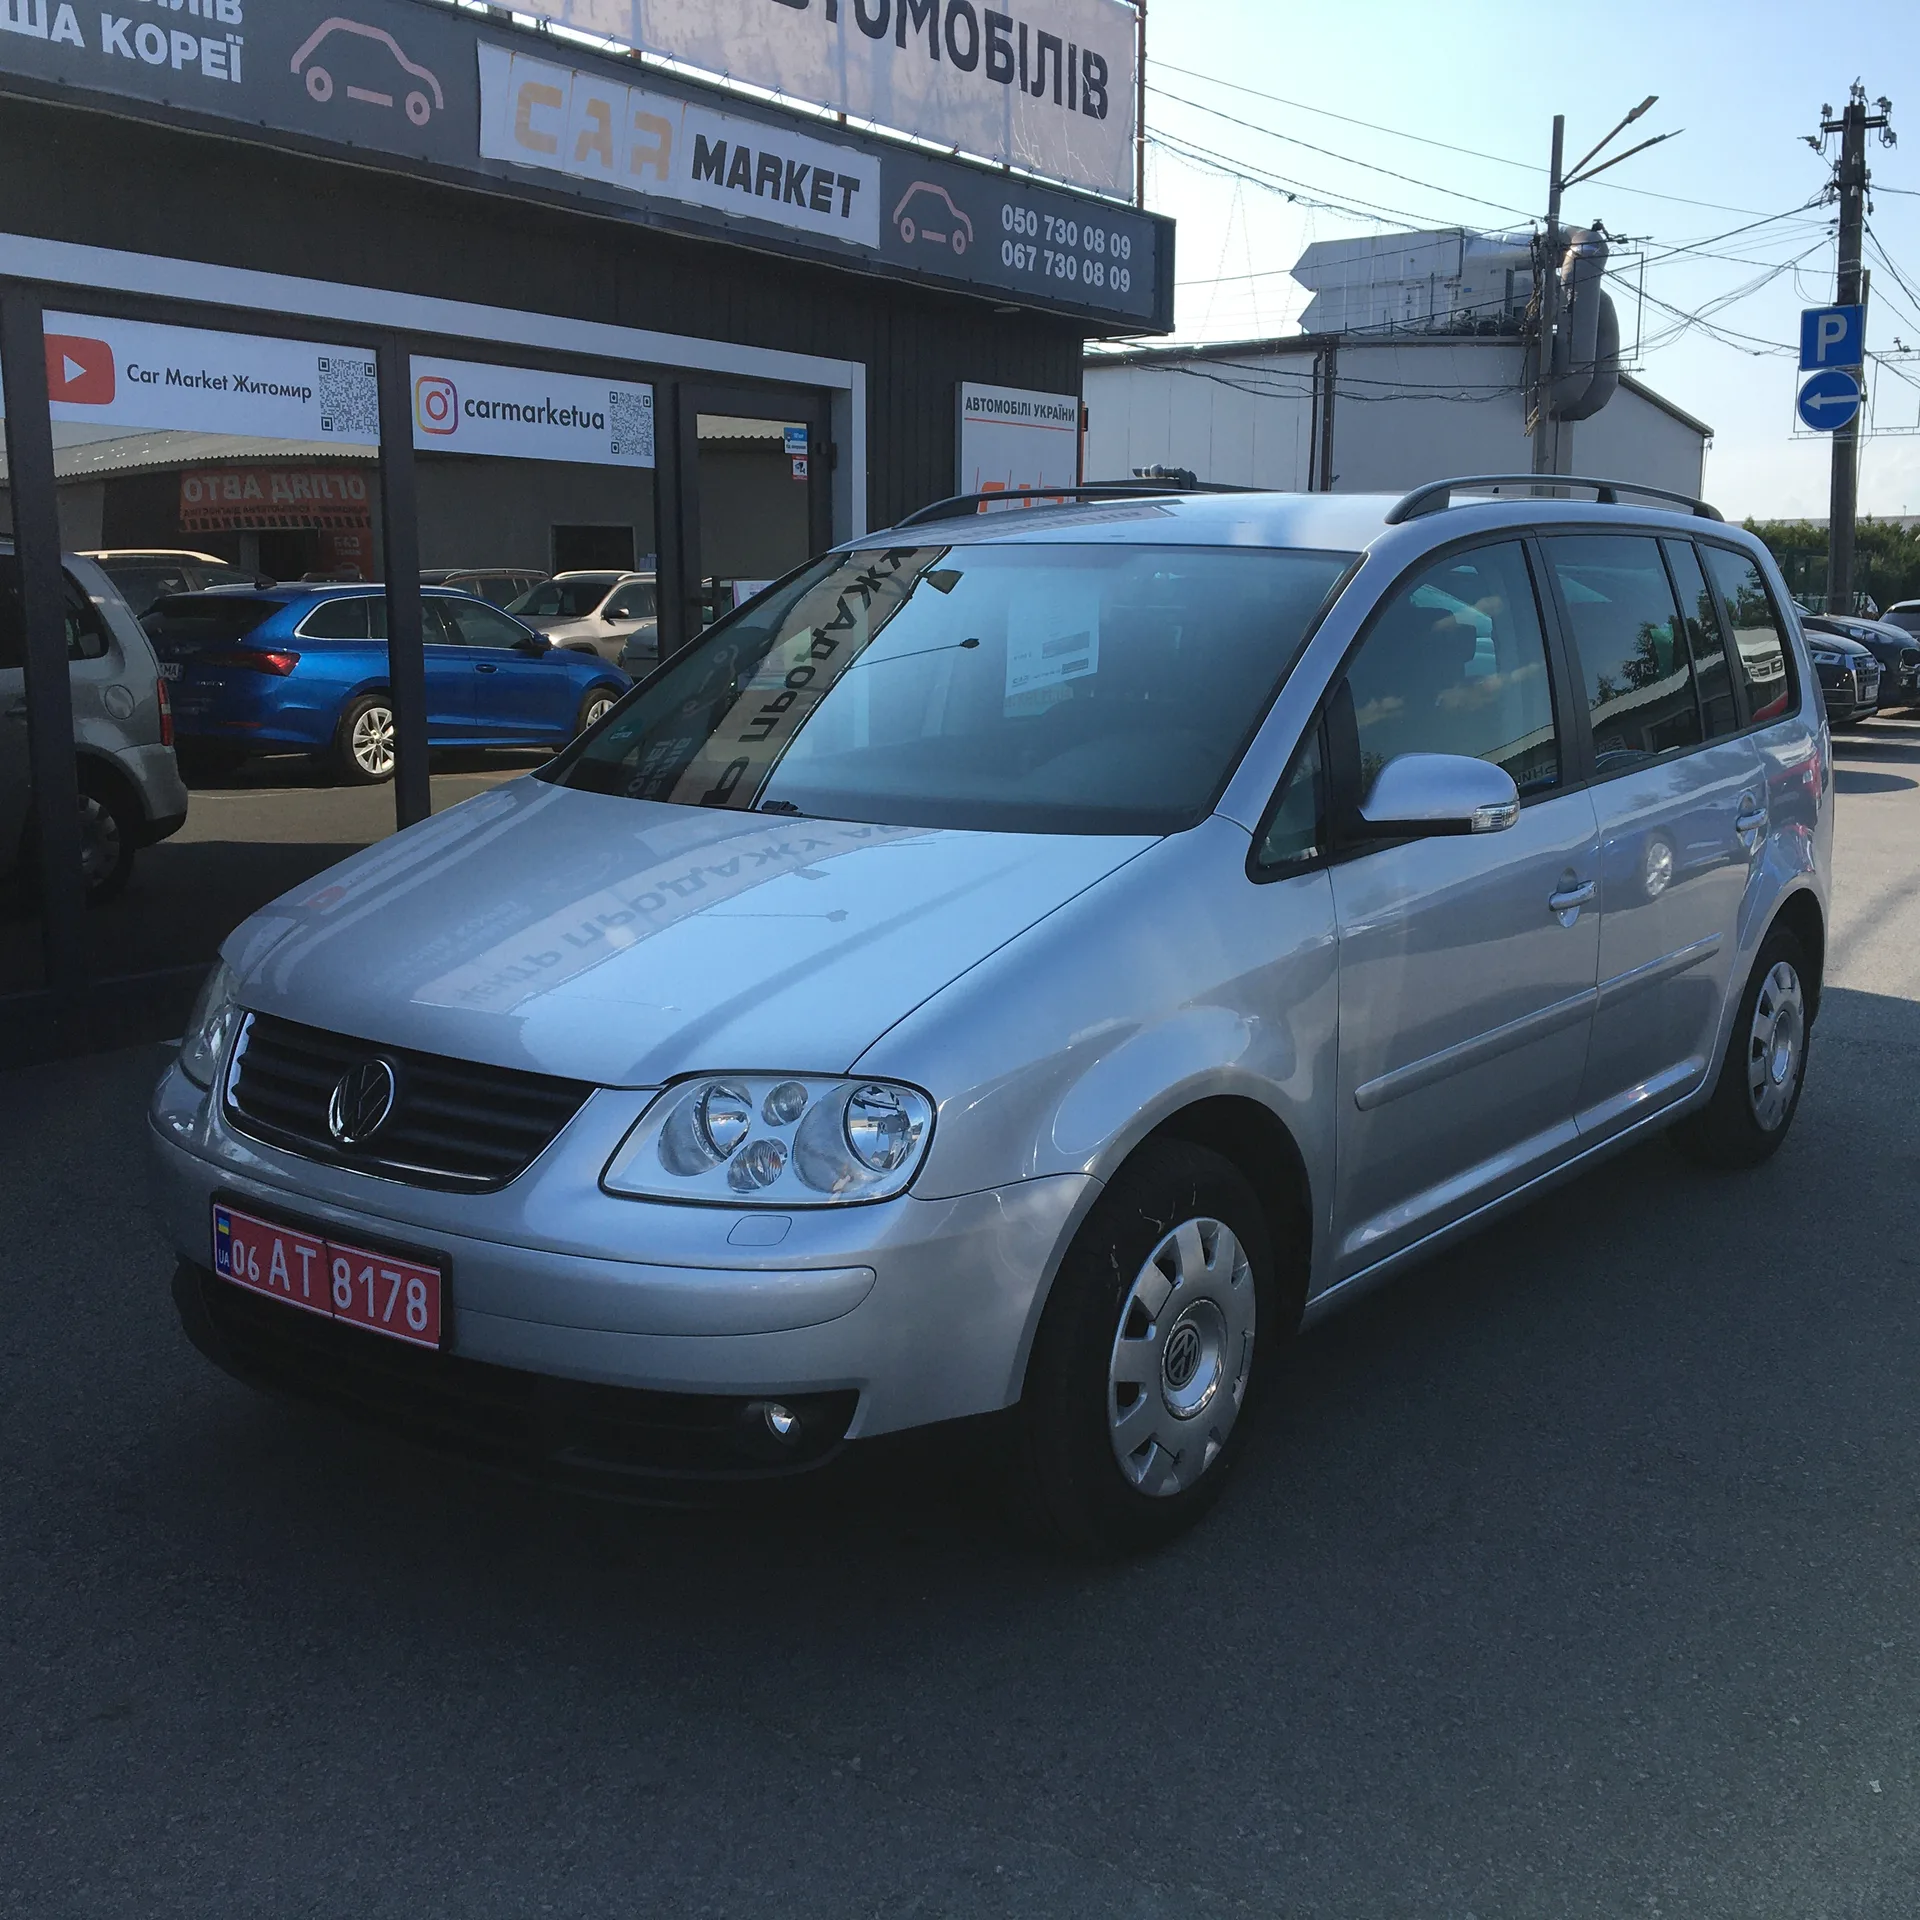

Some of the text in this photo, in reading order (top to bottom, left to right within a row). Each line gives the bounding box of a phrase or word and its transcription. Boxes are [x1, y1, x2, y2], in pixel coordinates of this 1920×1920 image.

[100, 12, 244, 84] КОРЕЇ
[514, 80, 861, 219] CAR MARKET
[1001, 203, 1131, 260] 050 730 08 09
[1001, 239, 1131, 293] 067 730 08 09
[1817, 314, 1848, 362] P
[127, 363, 312, 403] Car Market Житомир
[464, 396, 605, 430] carmarketua
[965, 396, 1075, 422] АВТОМОБІЛІ УКРАЇНИ
[218, 1248, 230, 1268] UA
[231, 1237, 429, 1333] 06 AT 8178
